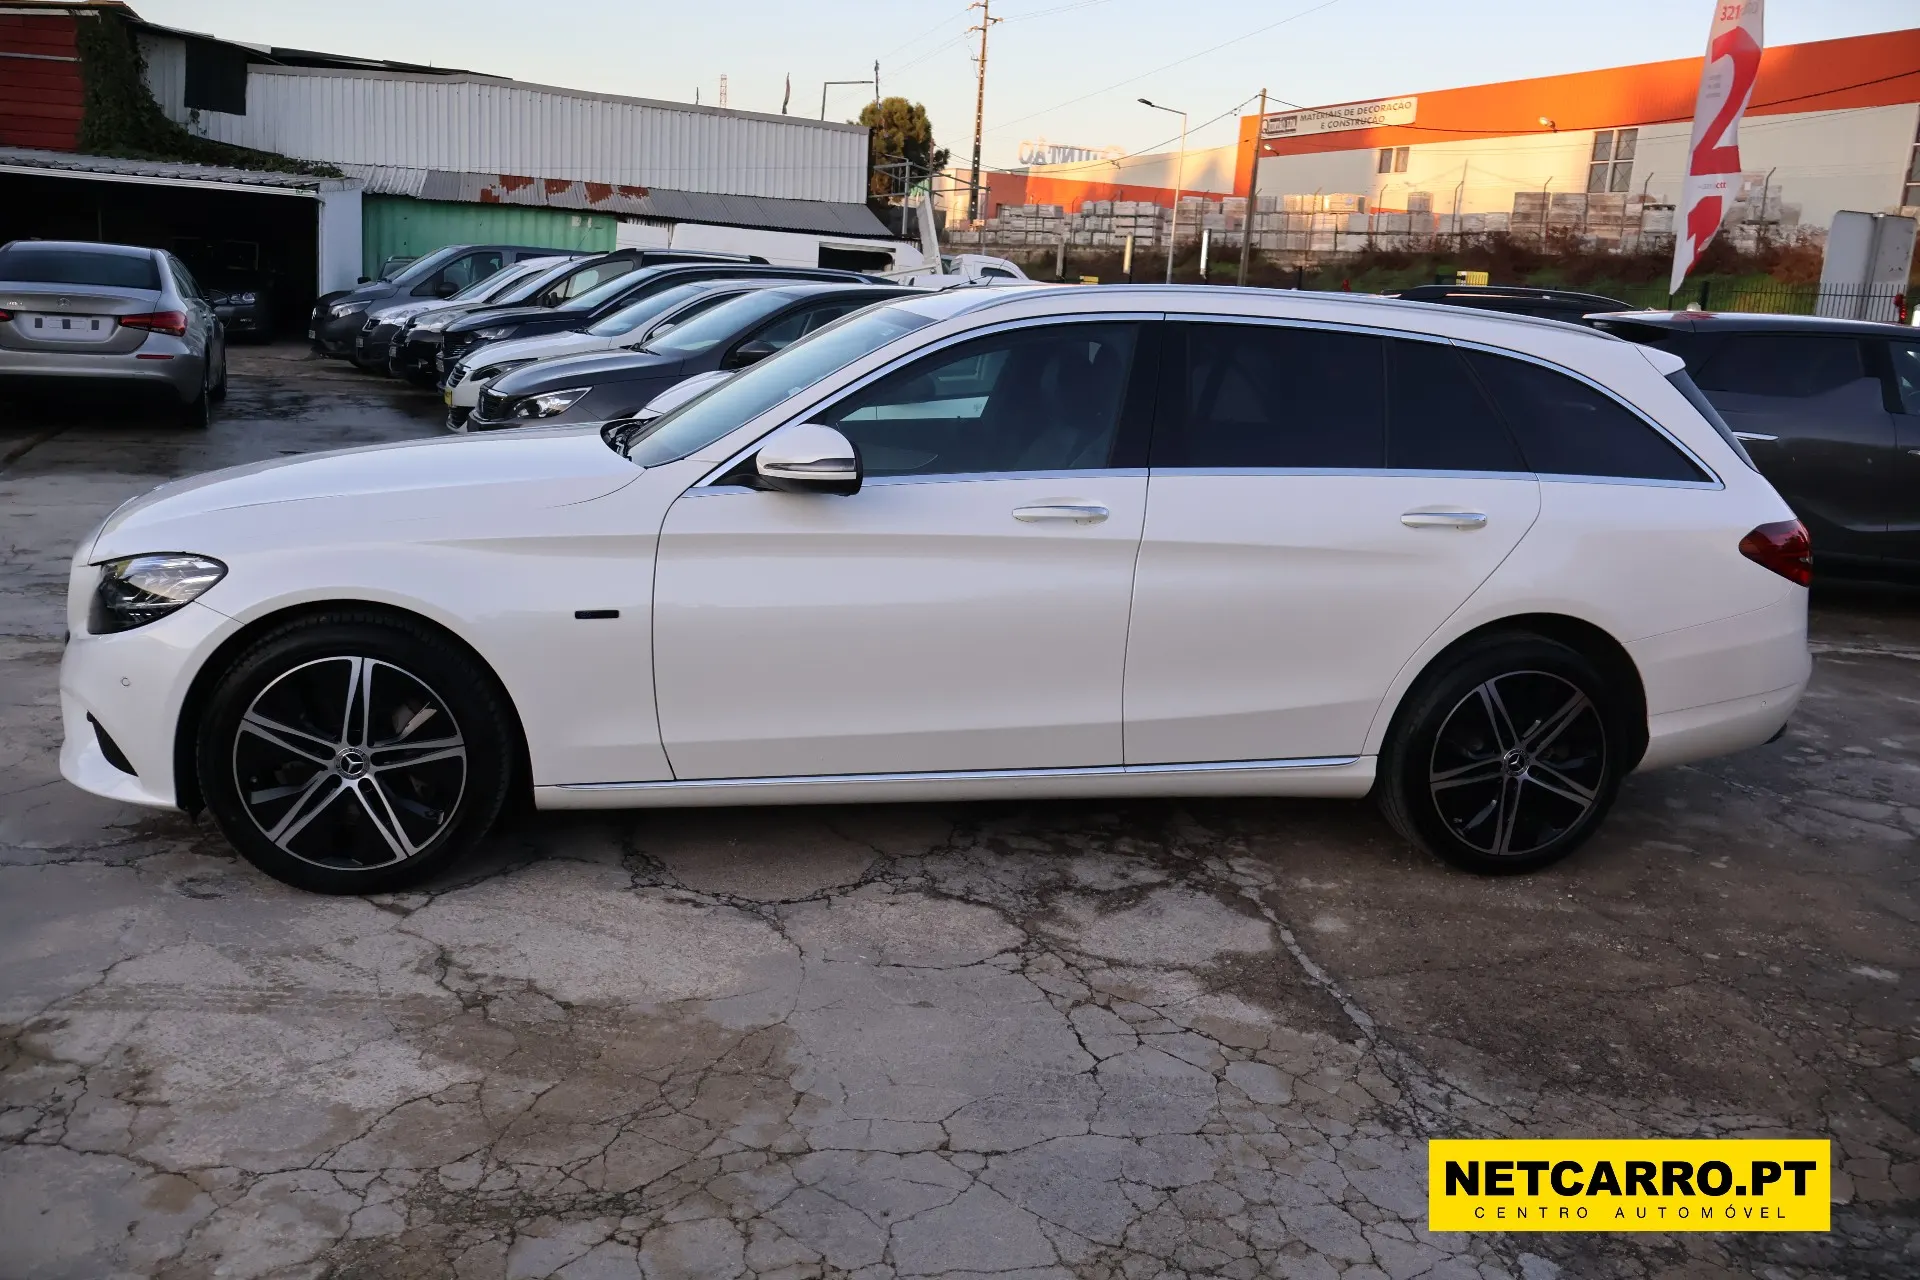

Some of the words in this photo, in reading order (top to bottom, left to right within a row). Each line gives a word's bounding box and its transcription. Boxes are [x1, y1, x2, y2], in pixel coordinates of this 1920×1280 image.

[1299, 109, 1342, 122] MATERIAIS
[1343, 108, 1355, 116] DE
[1356, 100, 1412, 115] DECORAÇÃO
[1320, 121, 1325, 130] E
[1327, 113, 1385, 129] CONSTRUÇÃO
